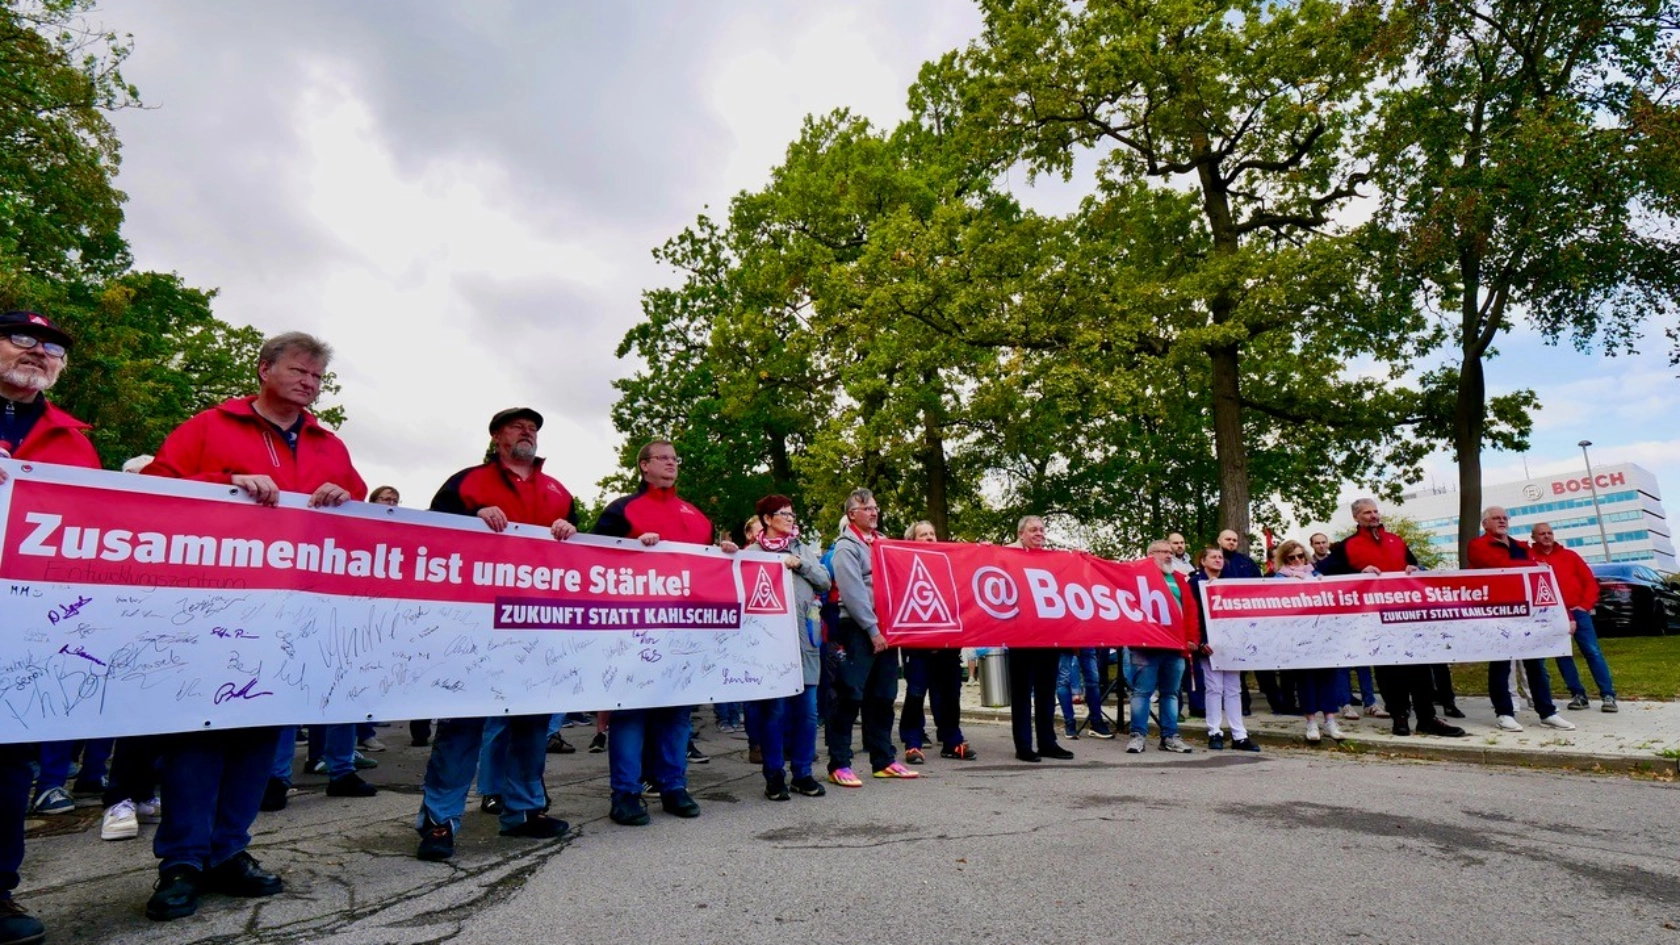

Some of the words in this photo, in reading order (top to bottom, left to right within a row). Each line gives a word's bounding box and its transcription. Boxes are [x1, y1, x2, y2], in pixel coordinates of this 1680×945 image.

[1551, 471, 1626, 495] BOSCH
[18, 512, 404, 580] Zusammenhalt
[415, 546, 463, 583] ist
[473, 561, 582, 593] unsere
[589, 565, 691, 597] Stärke!
[1211, 591, 1336, 611] Zusammenhalt
[1338, 588, 1360, 606] ist
[1365, 589, 1422, 605] unsere
[1424, 585, 1489, 602] Stärke!
[500, 604, 584, 625] ZUKUNFT
[588, 607, 641, 625] STATT
[644, 607, 738, 625] KAHLSCHLAG
[1382, 609, 1427, 622] ZUKUNFT
[1429, 607, 1460, 619] STATT
[1462, 605, 1527, 617] KAHLSCHLAG
